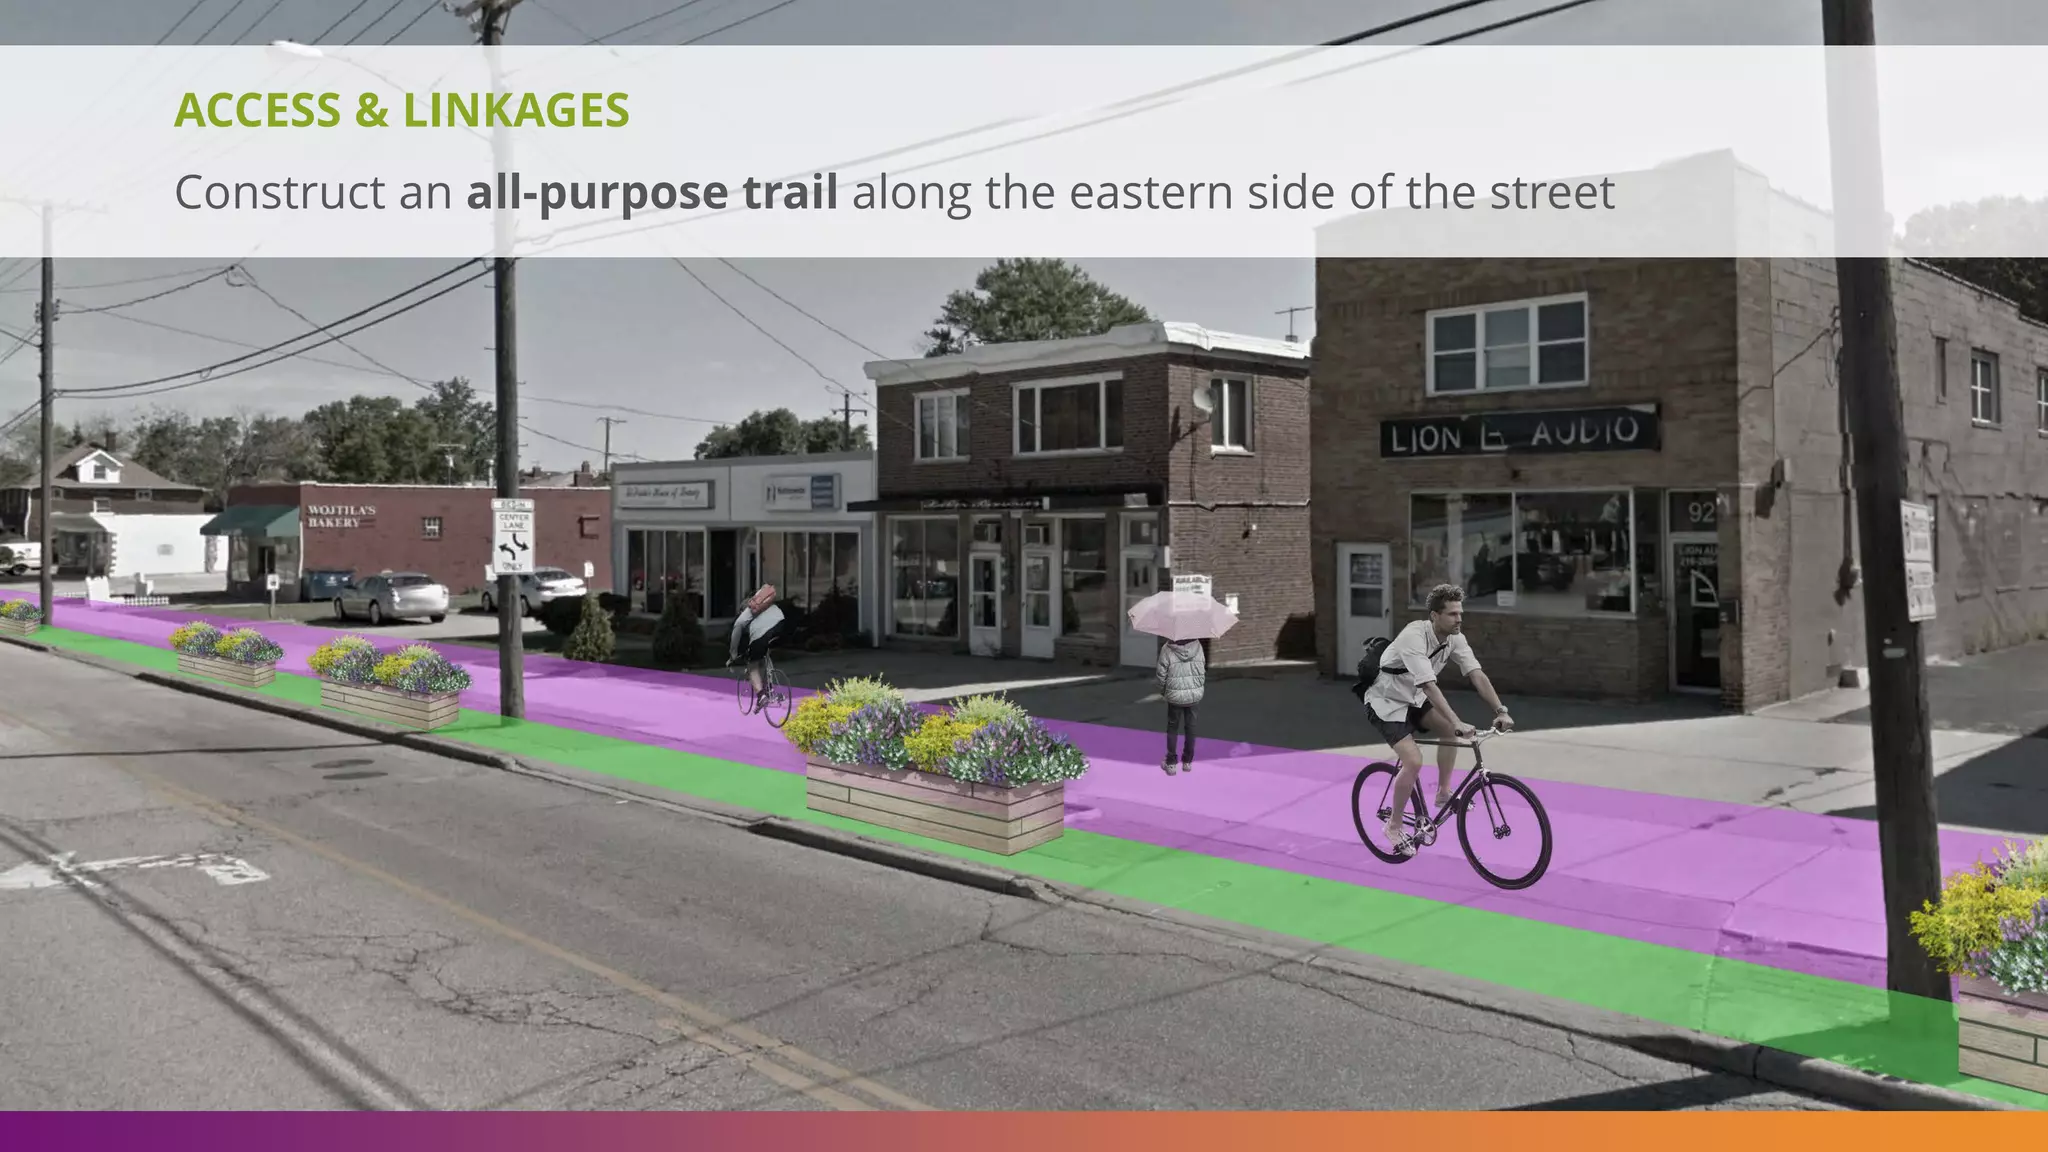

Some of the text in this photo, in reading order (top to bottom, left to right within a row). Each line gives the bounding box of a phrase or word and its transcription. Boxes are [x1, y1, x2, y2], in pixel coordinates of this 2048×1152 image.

[1391, 415, 1639, 453] LION AUDIO
[308, 504, 377, 516] WOJTILA'S
[1688, 501, 1716, 523] 92
[308, 517, 360, 528] BAKERY
[499, 513, 530, 521] CENTER
[503, 521, 525, 530] LANE
